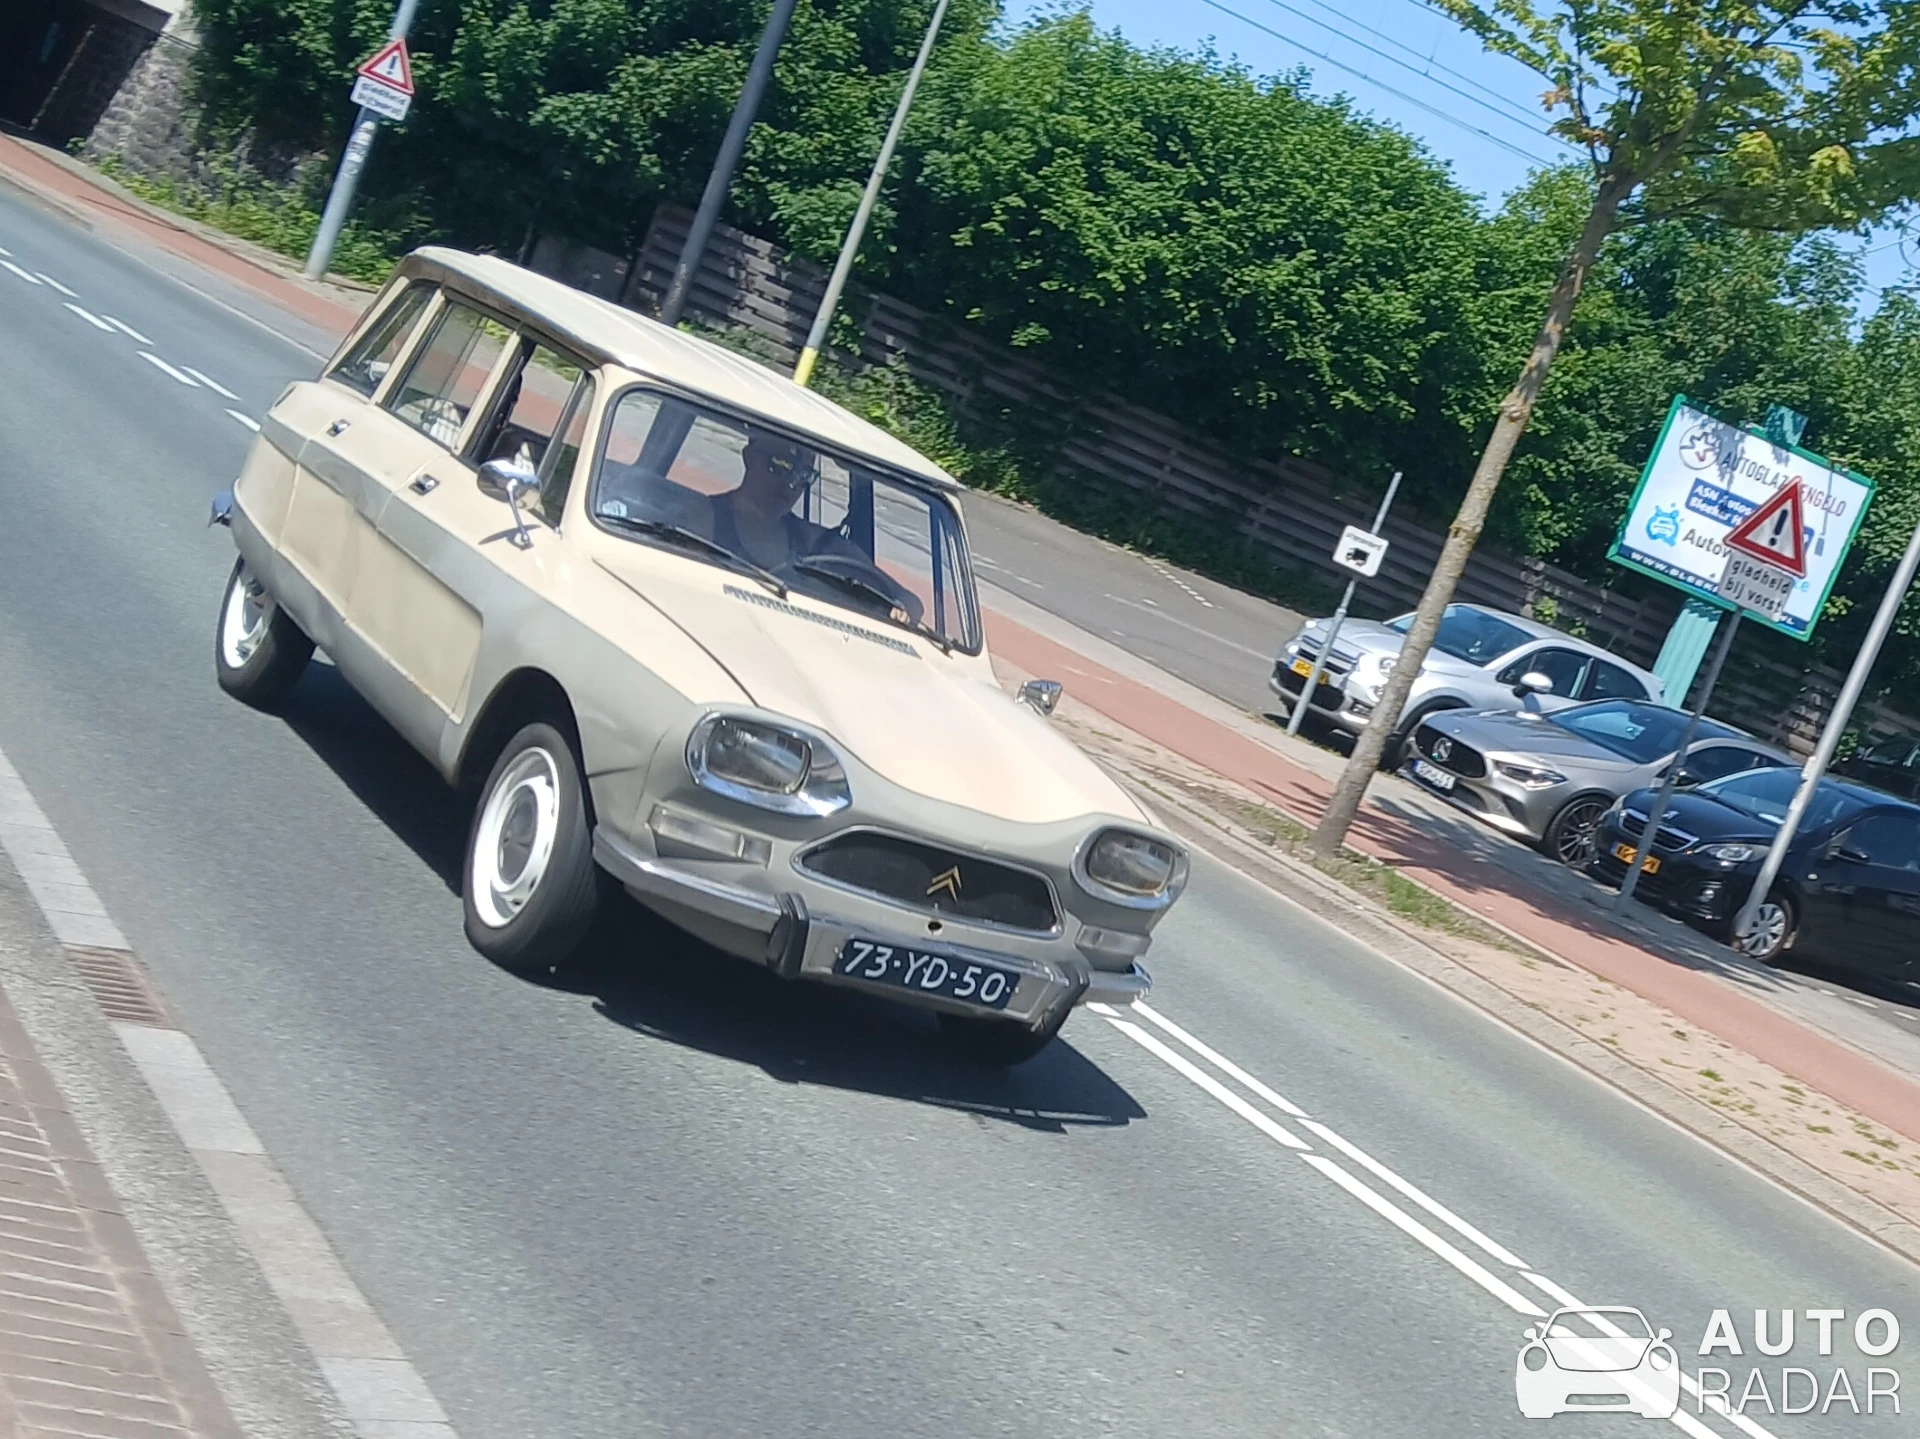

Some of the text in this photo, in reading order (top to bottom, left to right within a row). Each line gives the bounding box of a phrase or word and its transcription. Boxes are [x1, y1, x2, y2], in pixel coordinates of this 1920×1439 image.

[1719, 494, 1754, 517] Autos
[1799, 483, 1847, 518] ENGELO
[1724, 576, 1784, 614] bij vorst
[1731, 558, 1791, 596] gladheid
